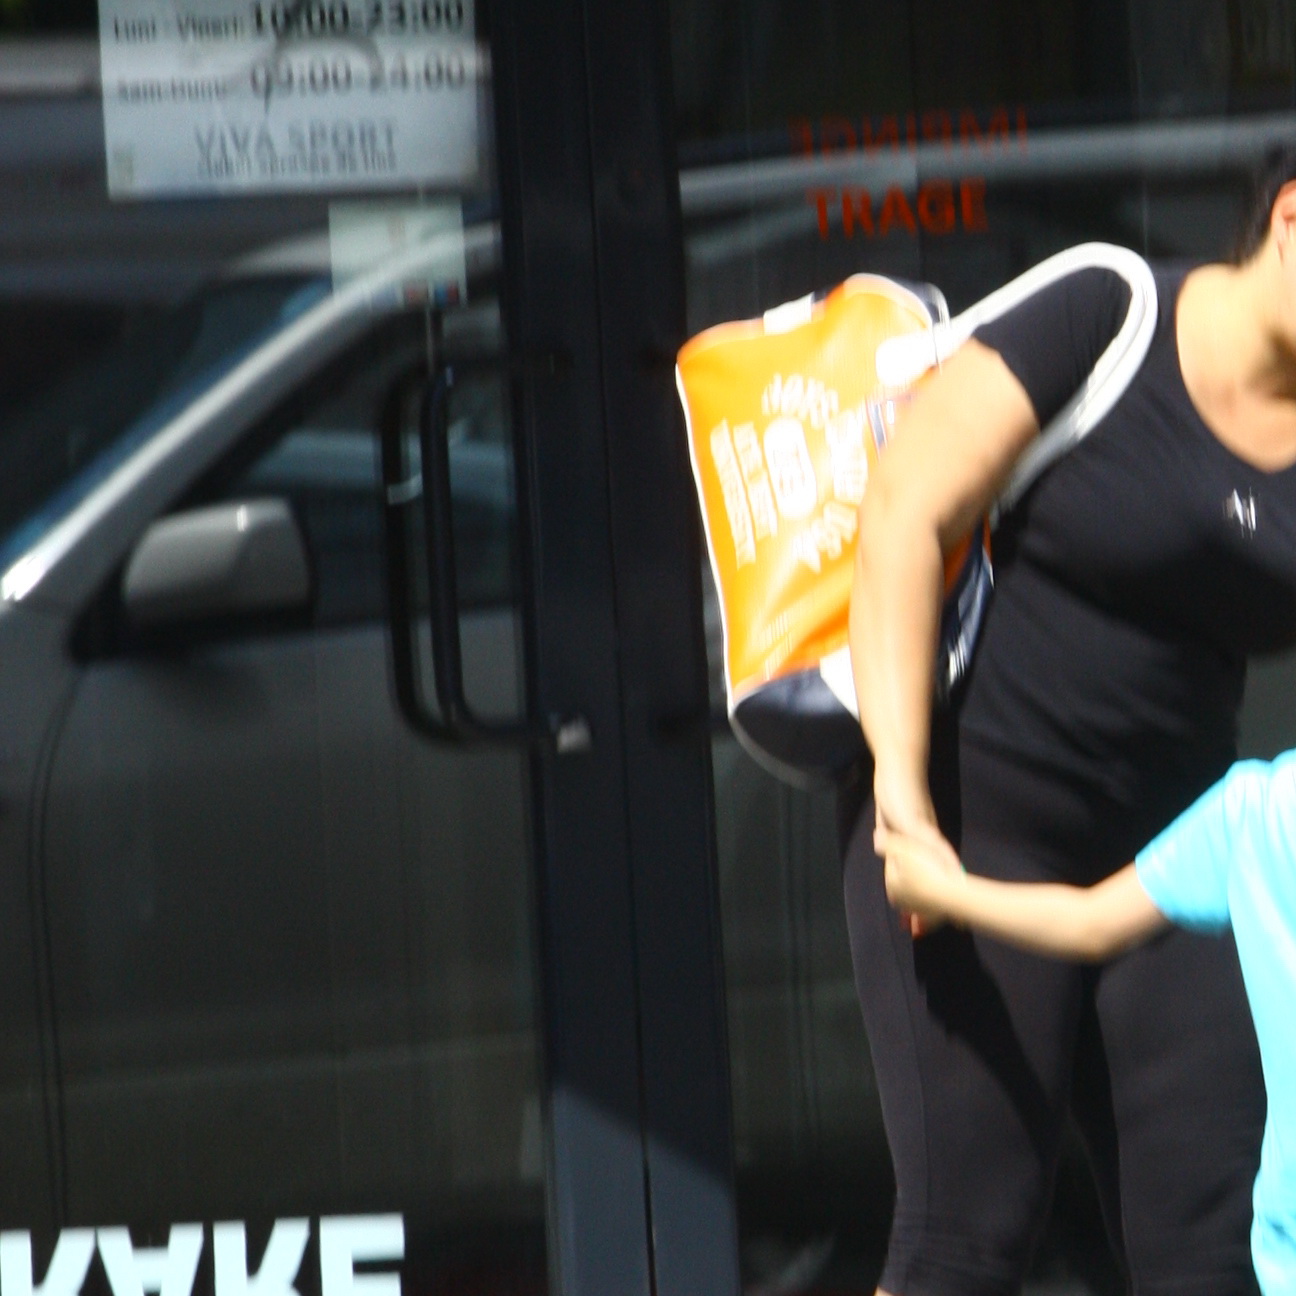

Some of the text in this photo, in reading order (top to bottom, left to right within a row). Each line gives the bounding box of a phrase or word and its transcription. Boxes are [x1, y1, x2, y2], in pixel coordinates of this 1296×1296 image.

[194, 115, 398, 161] VIVA SPORT
[804, 173, 991, 243] TRAGE
